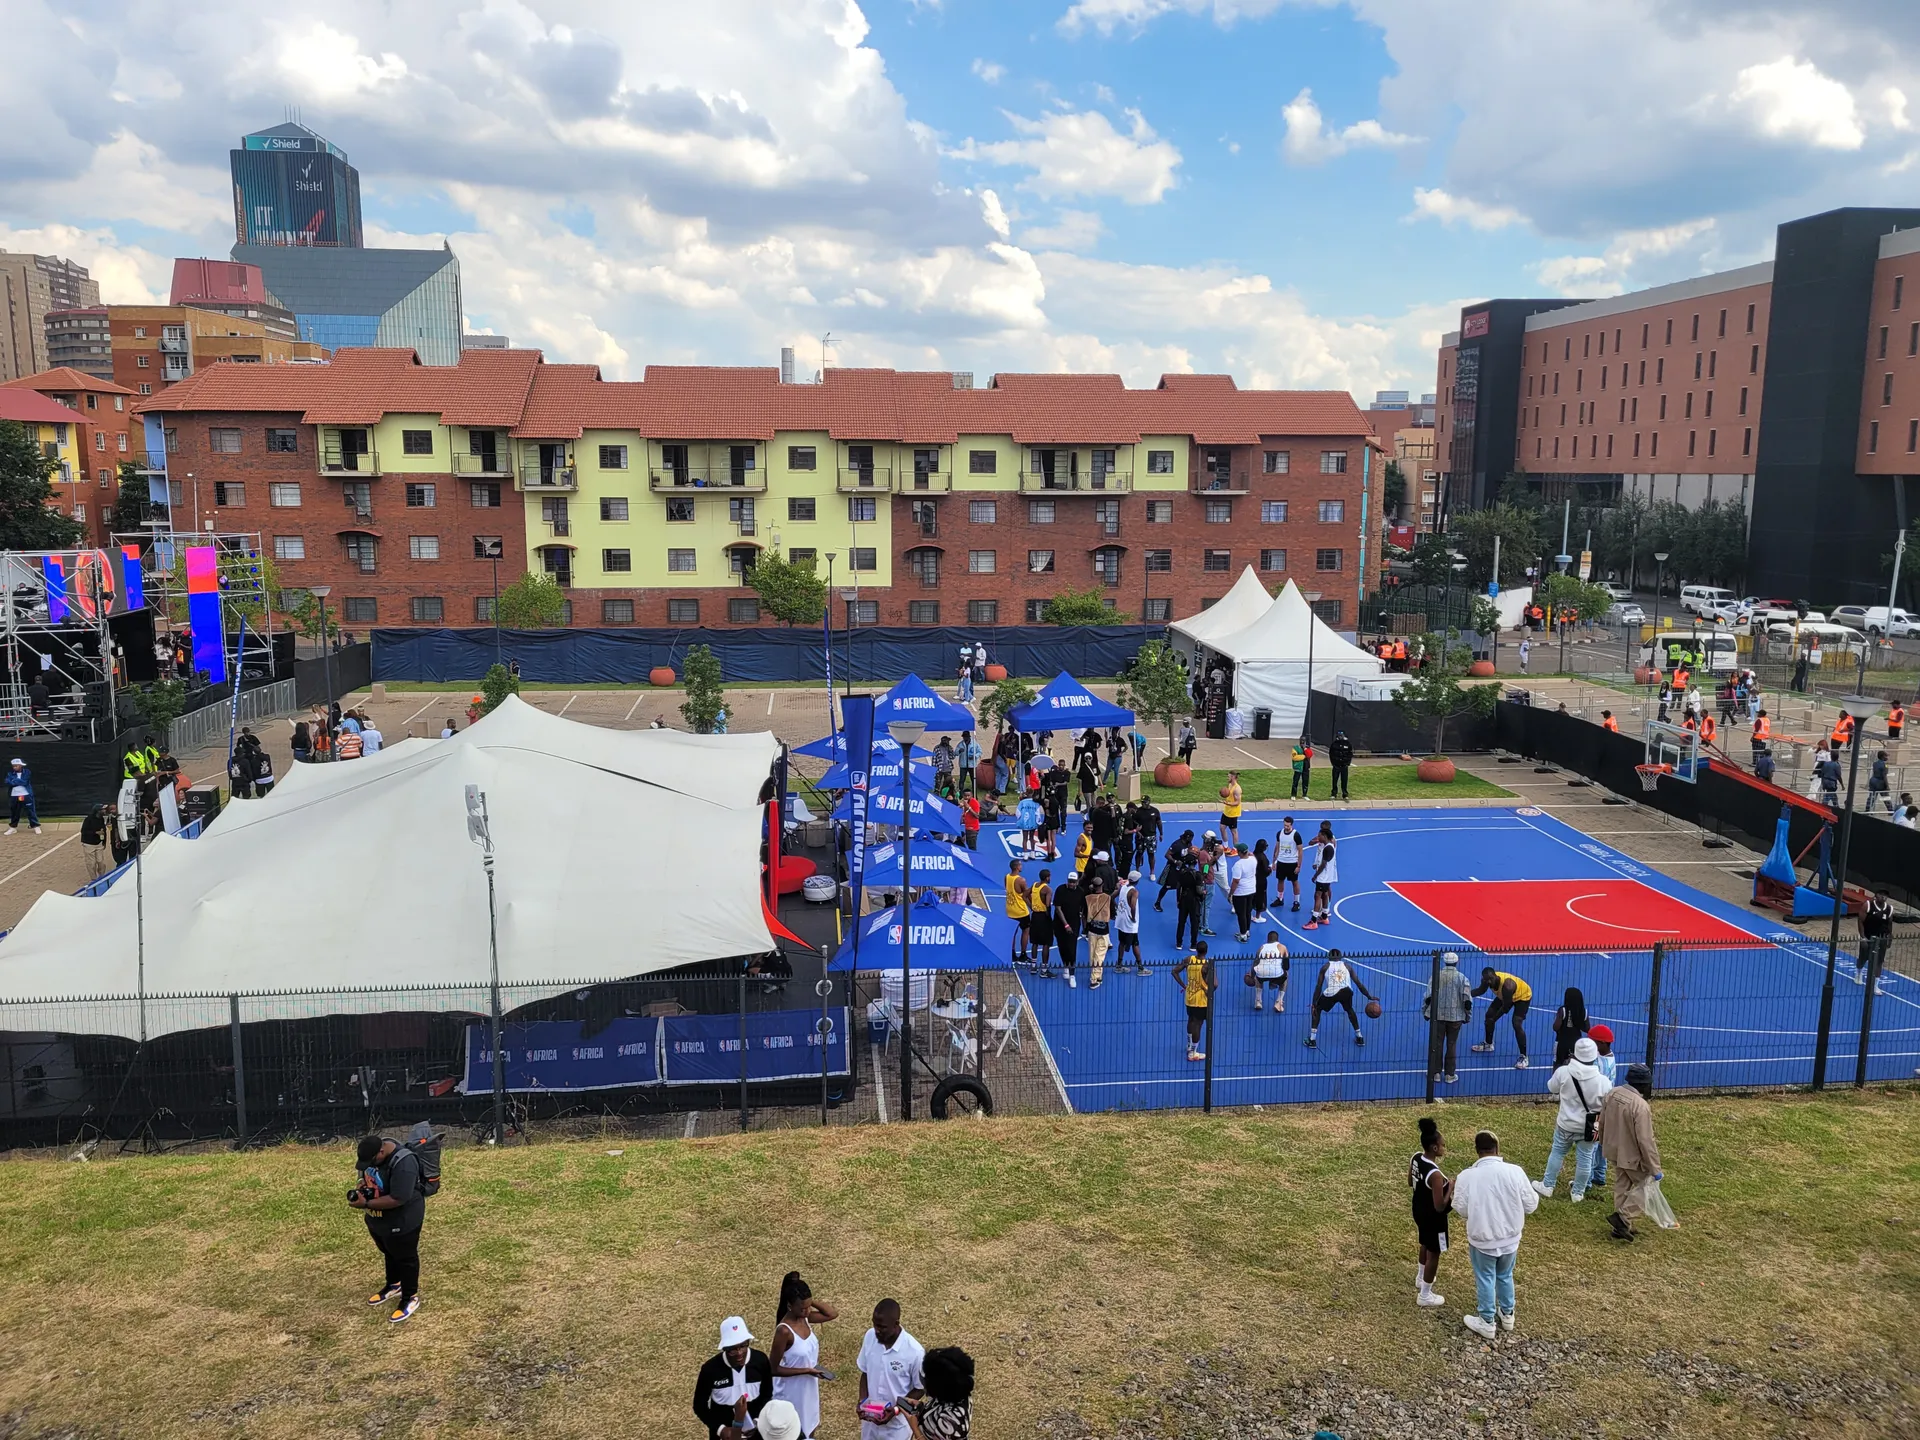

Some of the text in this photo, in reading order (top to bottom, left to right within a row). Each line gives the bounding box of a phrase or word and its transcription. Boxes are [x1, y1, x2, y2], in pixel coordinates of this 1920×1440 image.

[272, 138, 301, 149] Shield
[295, 180, 323, 191] Shield
[902, 697, 935, 709] AFRICA
[1060, 695, 1092, 708] AFRICA
[870, 765, 899, 776] FRICA
[886, 796, 924, 814] AFRCA
[910, 855, 955, 871] AFRICA
[680, 1041, 705, 1054] AFRICA
[725, 1038, 750, 1052] AFRIA
[769, 1035, 794, 1049] AFRICA
[532, 1049, 558, 1062] AFRICA
[578, 1047, 604, 1060] AFRICA
[623, 1042, 647, 1056] AFRICA
